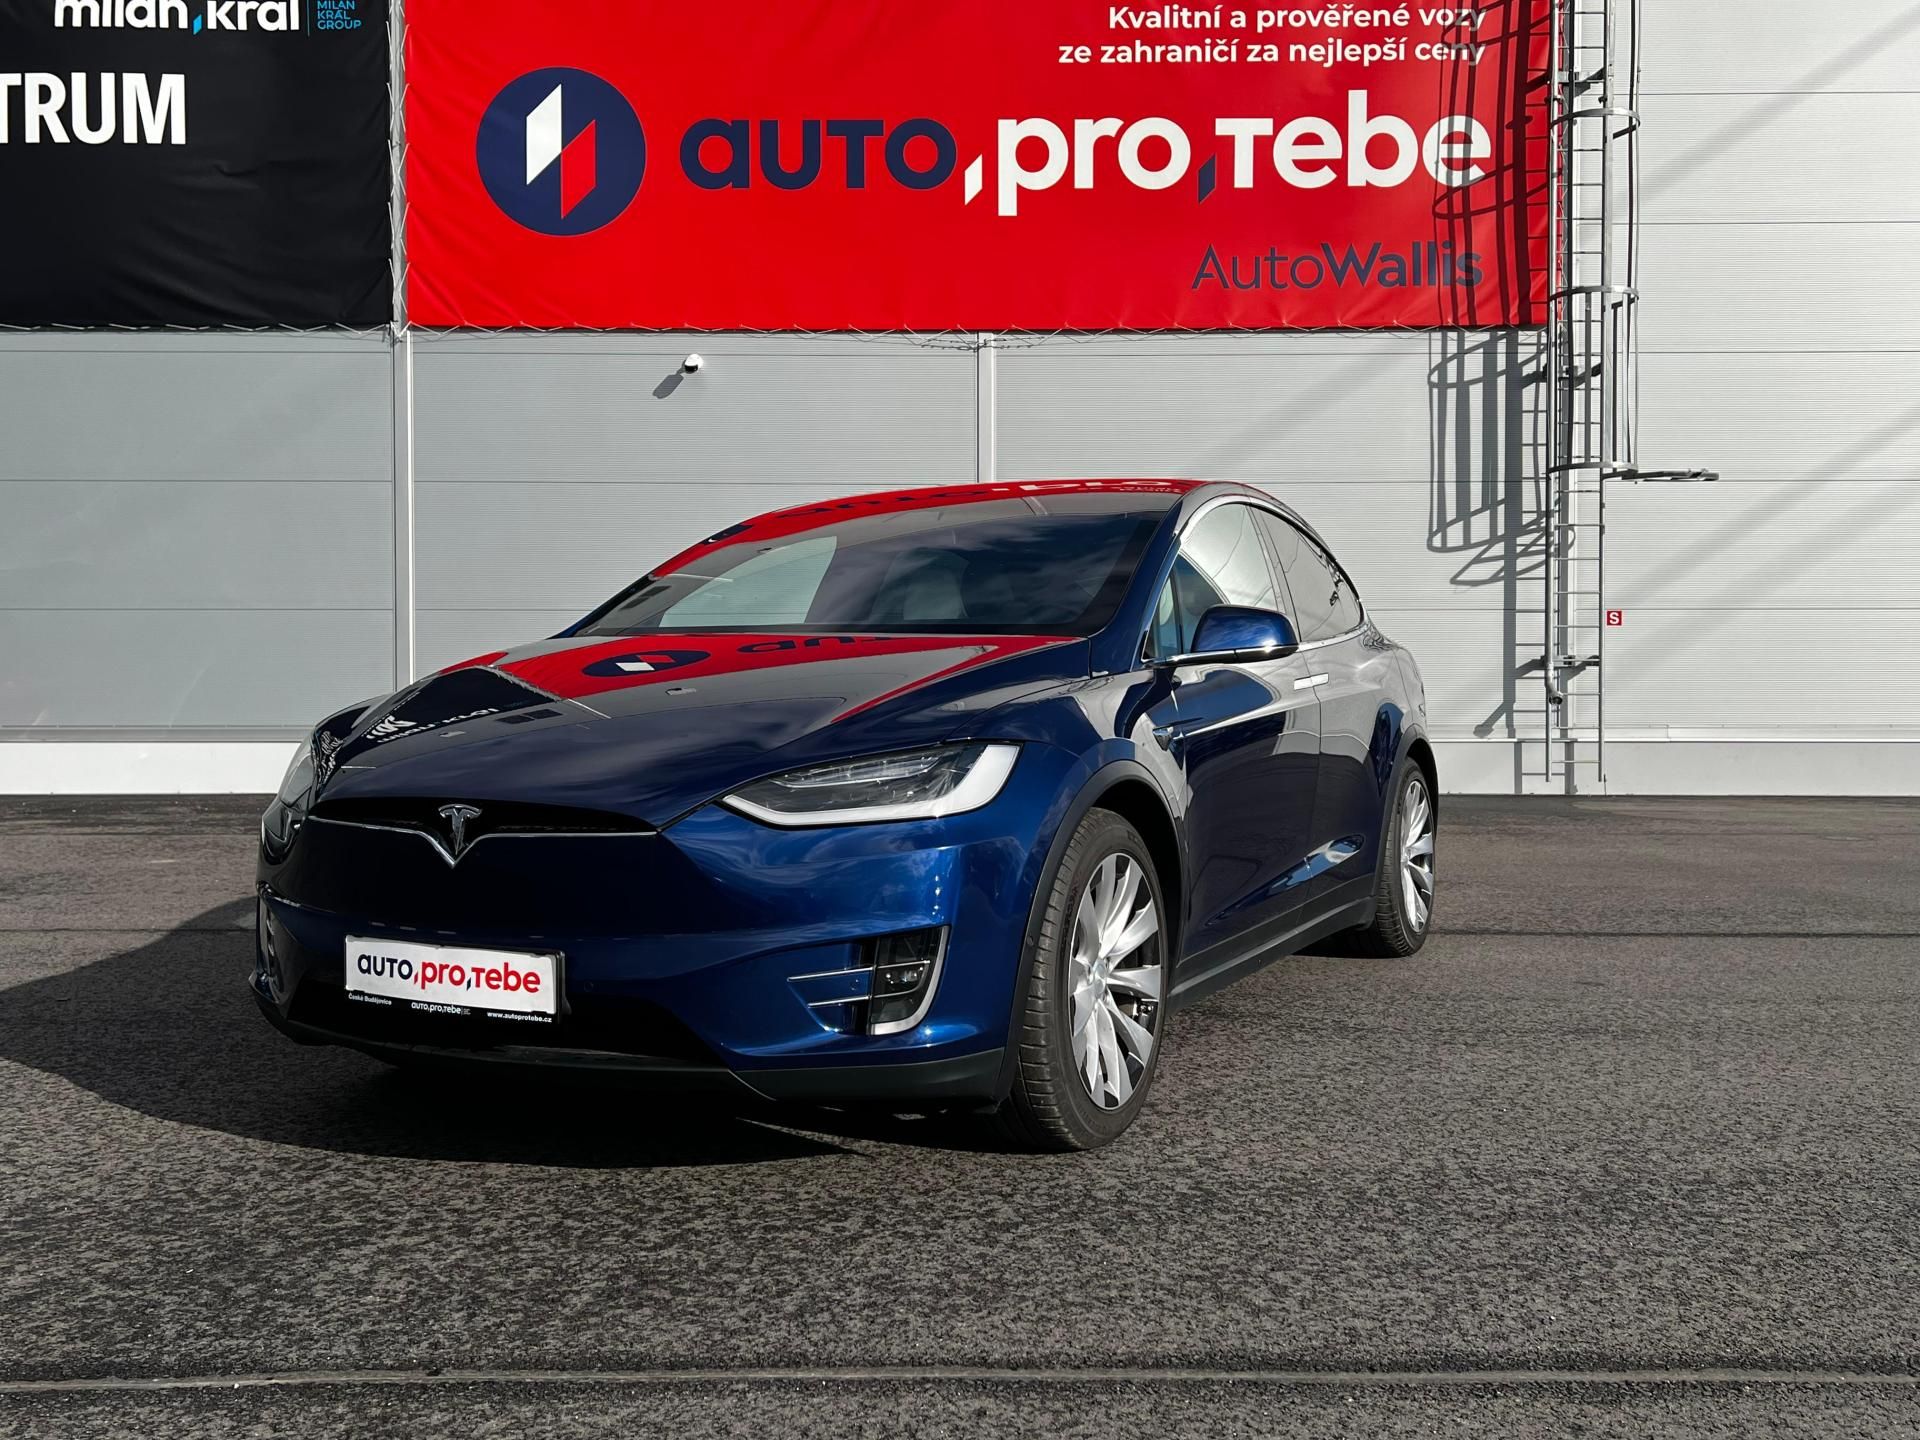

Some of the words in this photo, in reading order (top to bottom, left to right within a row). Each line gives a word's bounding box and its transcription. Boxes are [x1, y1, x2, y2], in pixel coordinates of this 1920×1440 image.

[317, 0, 355, 10] MILAN
[317, 19, 362, 30] GROUP
[1108, 4, 1223, 30] Kvalitní
[1229, 10, 1247, 29] a
[1256, 3, 1411, 34] prověřené
[1418, 8, 1487, 32] vozy
[1058, 44, 1092, 64] ze
[1100, 38, 1240, 63] zahraničí
[1246, 43, 1279, 62] za
[1288, 36, 1408, 68] nejlepší
[1414, 41, 1487, 66] ceny
[1191, 240, 1484, 290] AutoWallis
[1609, 611, 1620, 625] S
